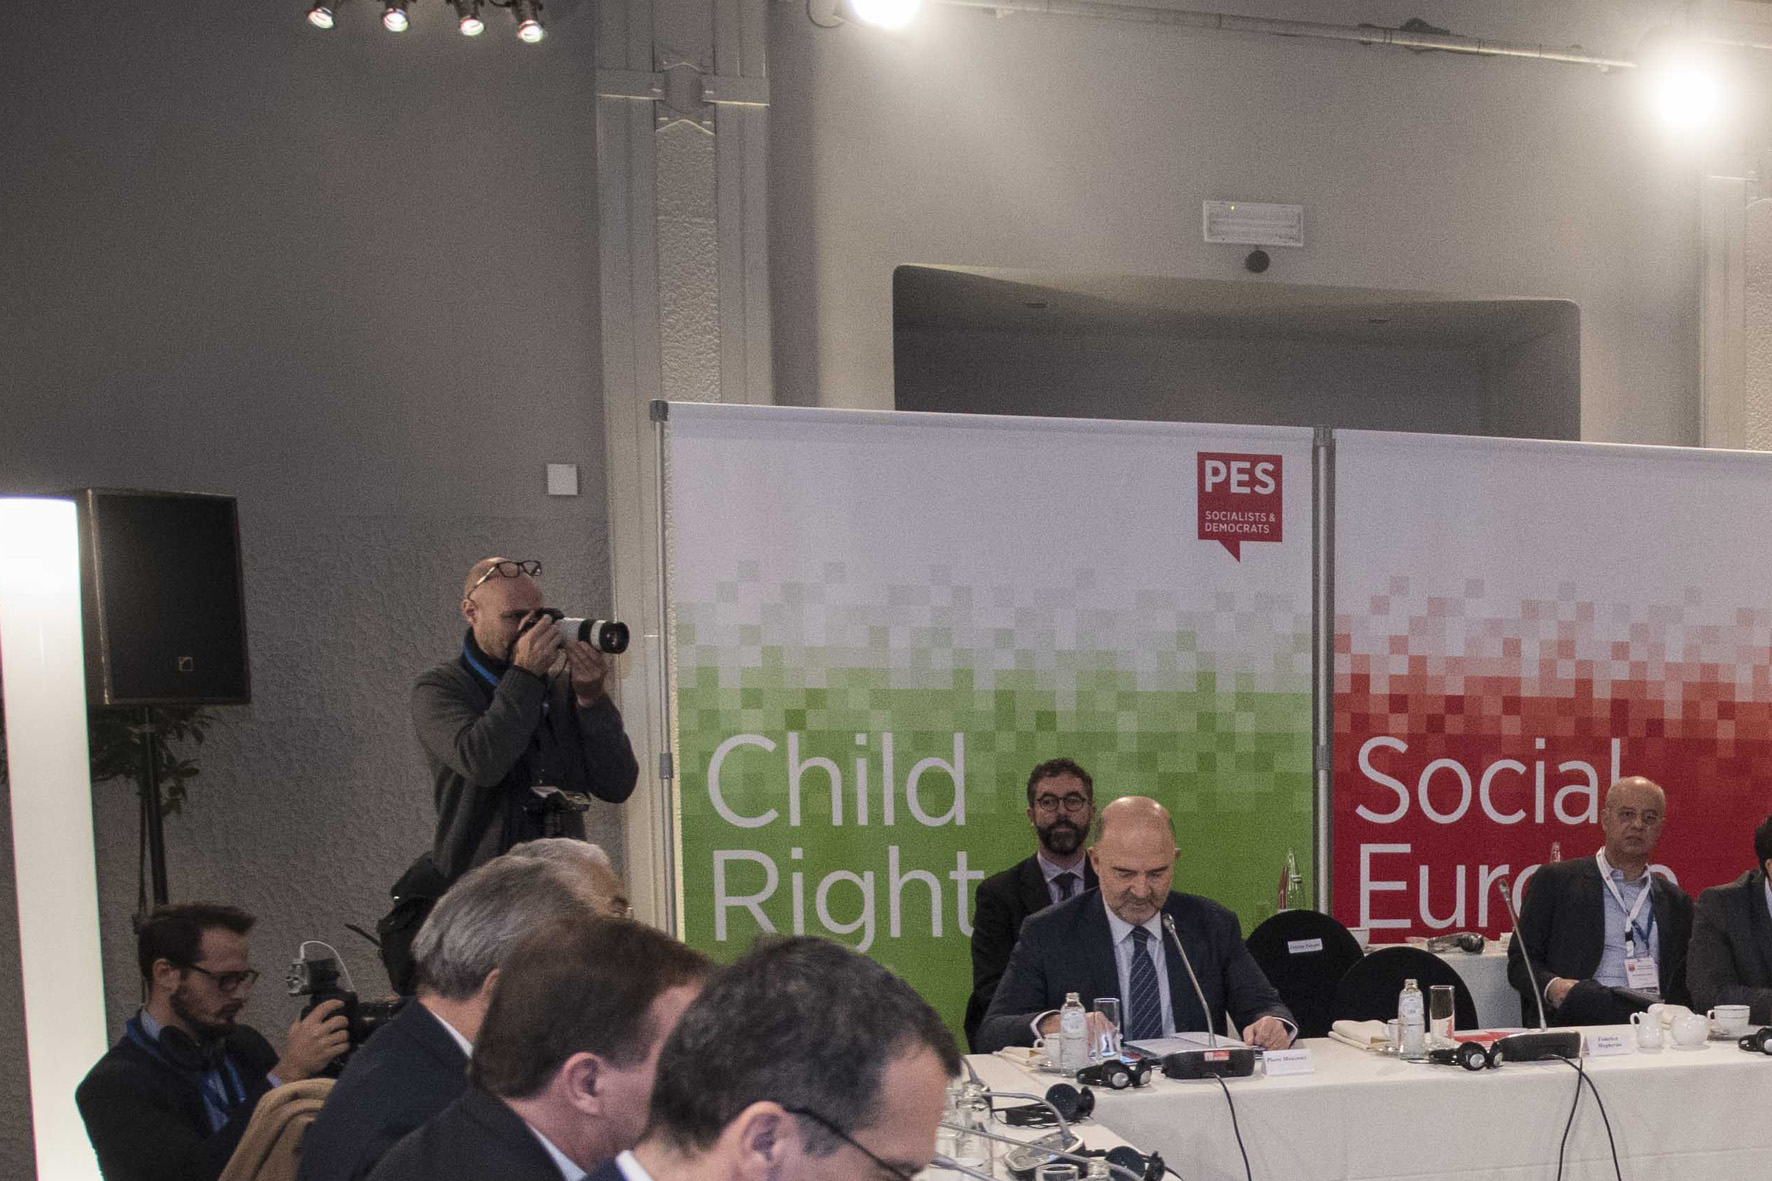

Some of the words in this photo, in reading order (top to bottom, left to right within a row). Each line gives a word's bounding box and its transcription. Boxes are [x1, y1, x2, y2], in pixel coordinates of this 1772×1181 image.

[1204, 460, 1275, 495] PES
[1205, 510, 1266, 522] SOCIALISTS
[1268, 513, 1275, 522] &
[1205, 522, 1270, 534] DEMOCRATS
[707, 732, 967, 828] Child
